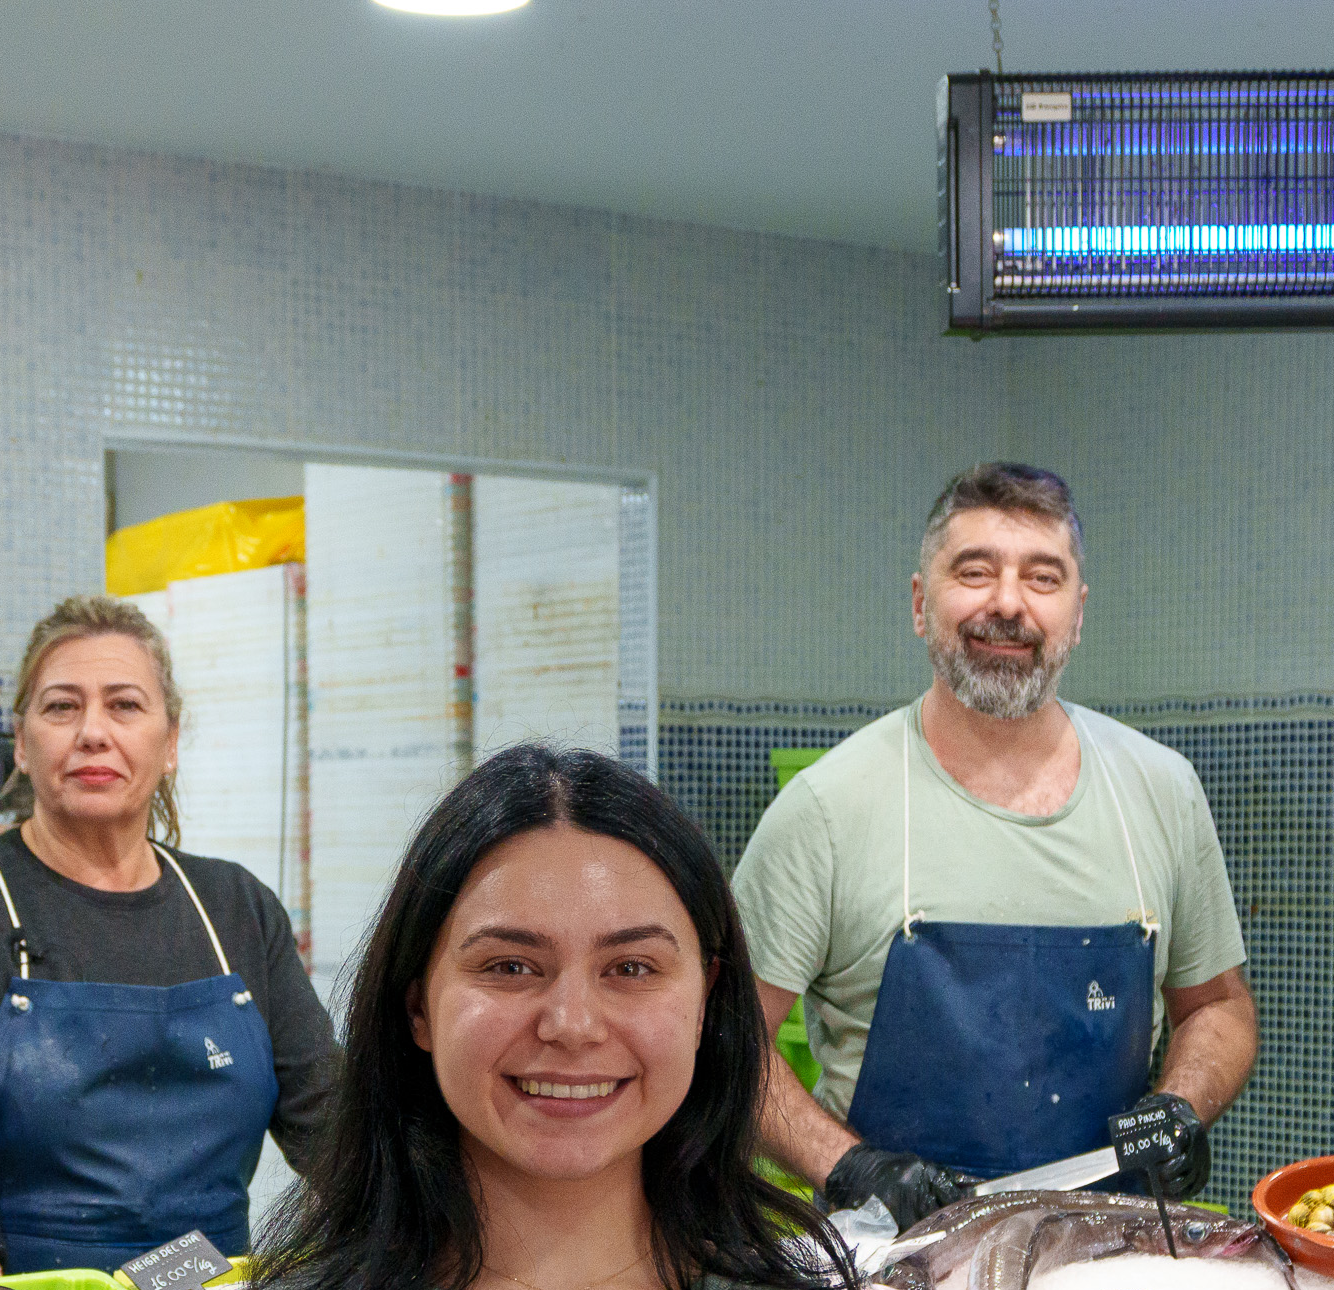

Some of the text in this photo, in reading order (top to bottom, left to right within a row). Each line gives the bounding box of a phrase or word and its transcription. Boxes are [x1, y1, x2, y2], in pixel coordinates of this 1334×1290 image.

[1138, 1110, 1166, 1125] PINCHO
[128, 1254, 161, 1274] MEIGA
[159, 1244, 180, 1258] DEL
